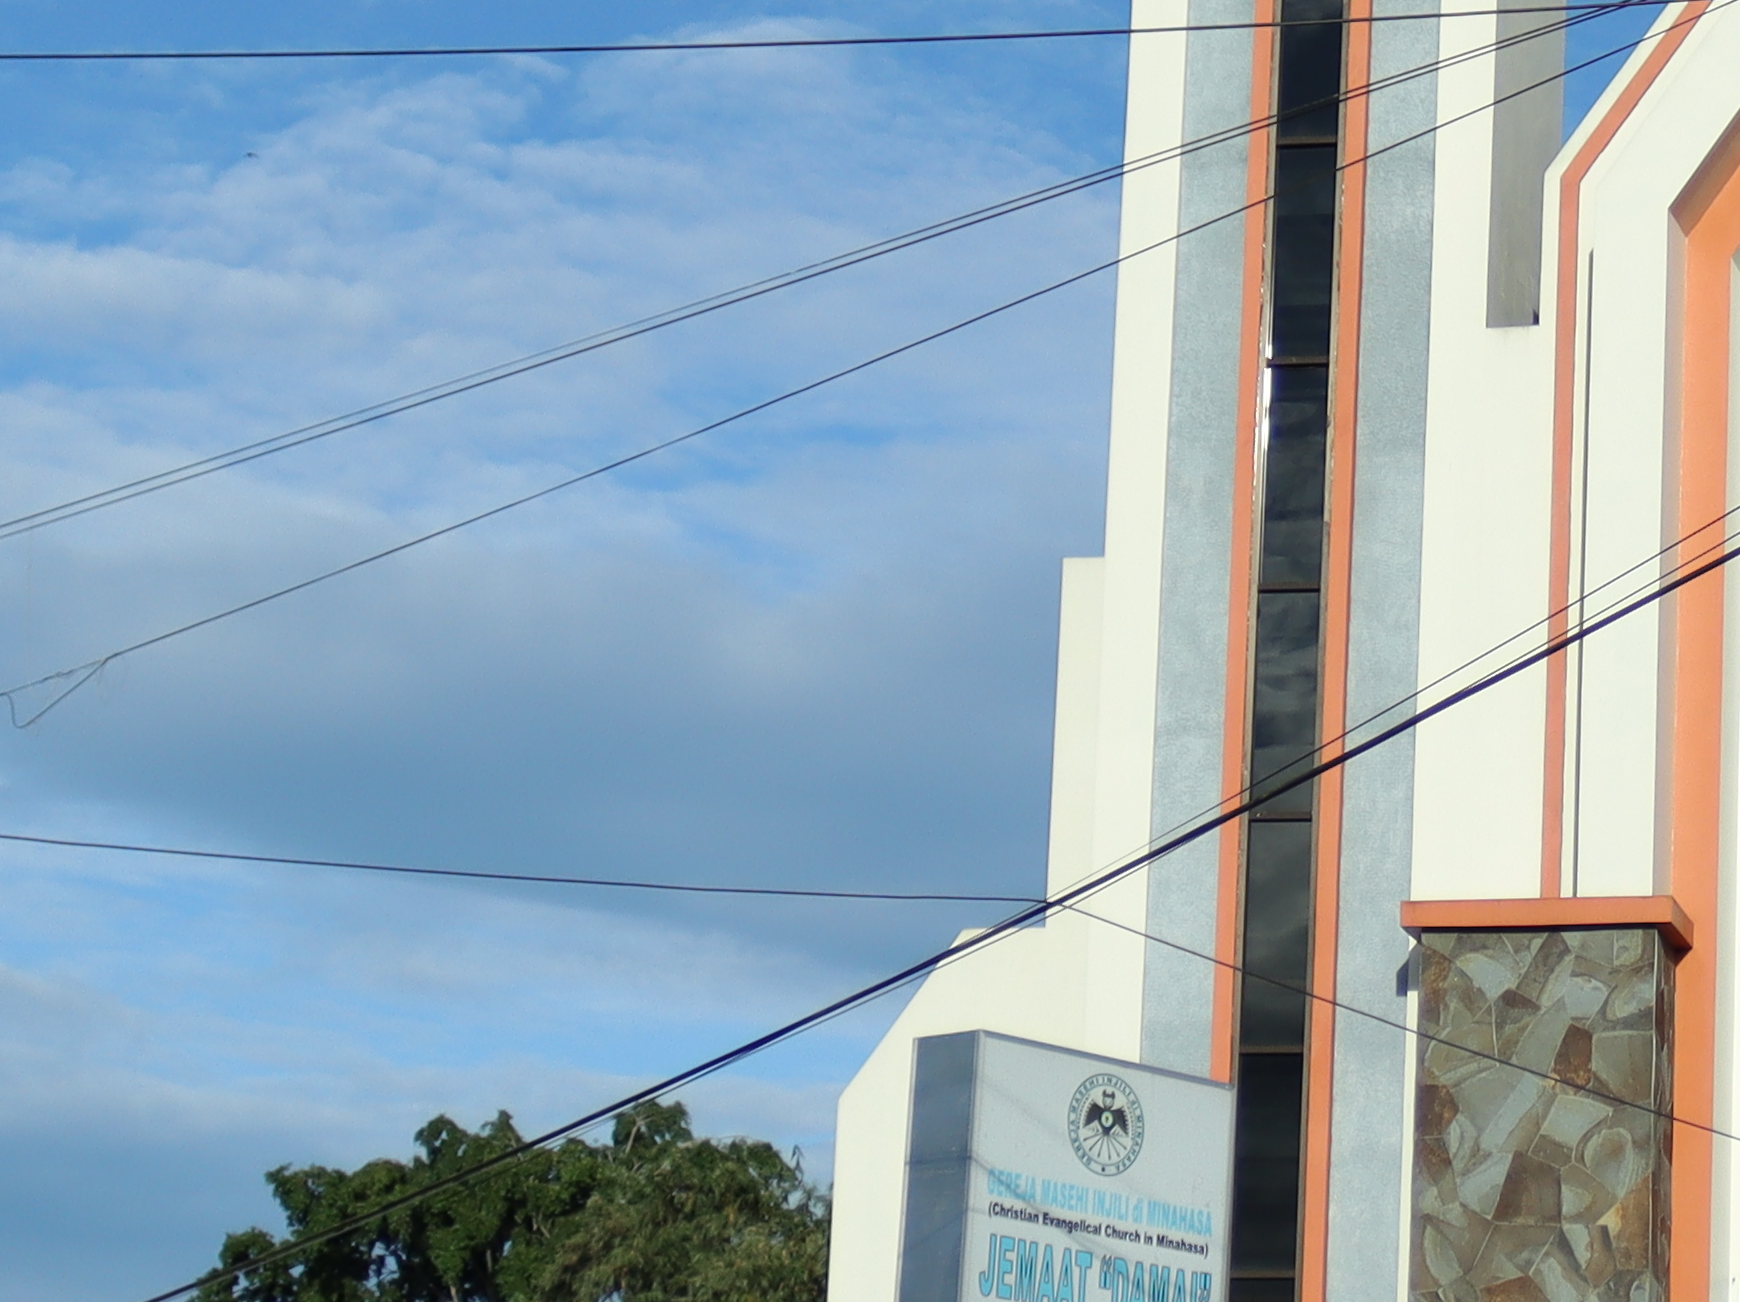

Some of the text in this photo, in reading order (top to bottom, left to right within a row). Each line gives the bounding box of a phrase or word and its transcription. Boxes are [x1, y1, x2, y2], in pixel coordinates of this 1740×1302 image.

[987, 1168, 1036, 1203] GEREJA
[1041, 1178, 1089, 1214] MASEHI
[1091, 1188, 1129, 1221] INJILI
[1146, 1199, 1213, 1237] MINAHASA
[988, 1201, 1209, 1259] (Christian Evangelical Church in Minahasa)
